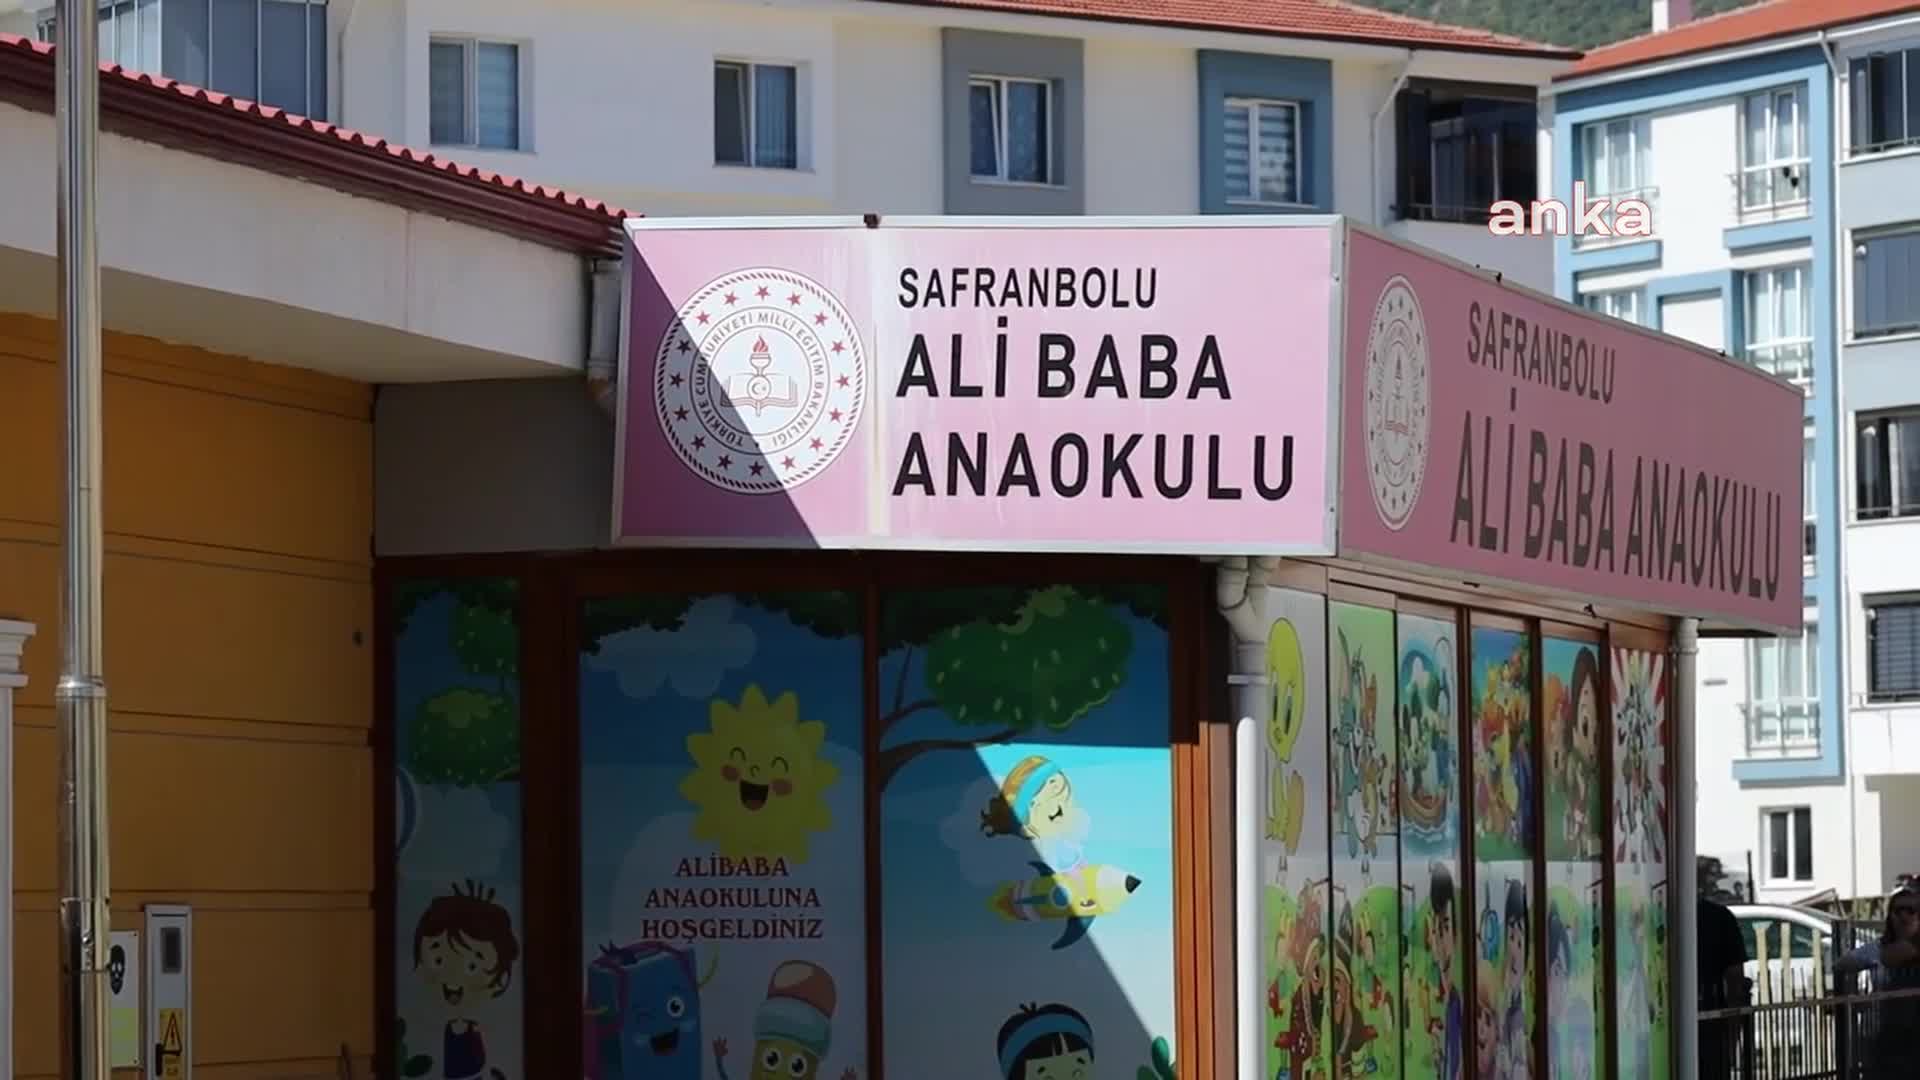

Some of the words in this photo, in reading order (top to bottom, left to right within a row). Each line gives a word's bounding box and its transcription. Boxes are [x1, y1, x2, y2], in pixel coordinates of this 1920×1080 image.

[898, 267, 1158, 309] SAFRANBOLU
[896, 316, 1007, 397] ALİ
[1037, 333, 1231, 400] BABA
[1467, 301, 1616, 404] SAFRANBOLU
[892, 432, 1294, 501] ANAOKULU
[1450, 387, 1517, 553] ALİ
[1523, 430, 1616, 573] BABA
[1623, 456, 1781, 601] ANAOKULU
[675, 852, 789, 877] ALİBABA
[644, 887, 821, 908] ANAOKULUNA
[641, 913, 823, 943] HOŞGELDİNİZ
